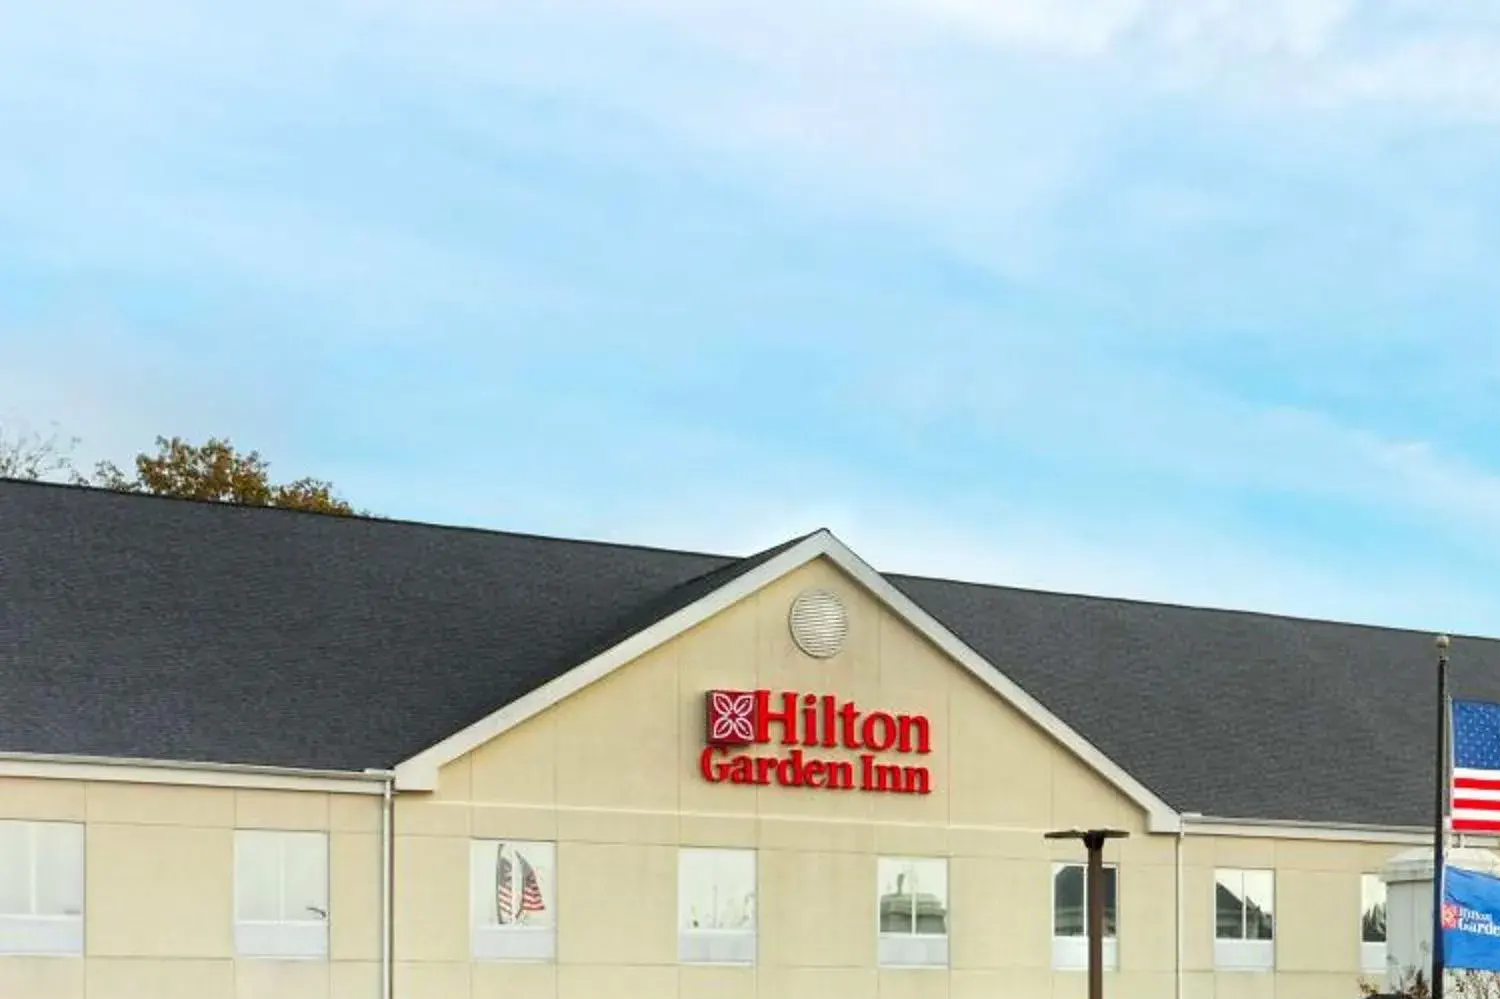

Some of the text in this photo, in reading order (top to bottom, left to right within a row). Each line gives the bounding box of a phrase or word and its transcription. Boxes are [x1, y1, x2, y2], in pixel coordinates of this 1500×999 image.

[757, 690, 931, 754] Hilton
[701, 745, 931, 795] Garden Inn
